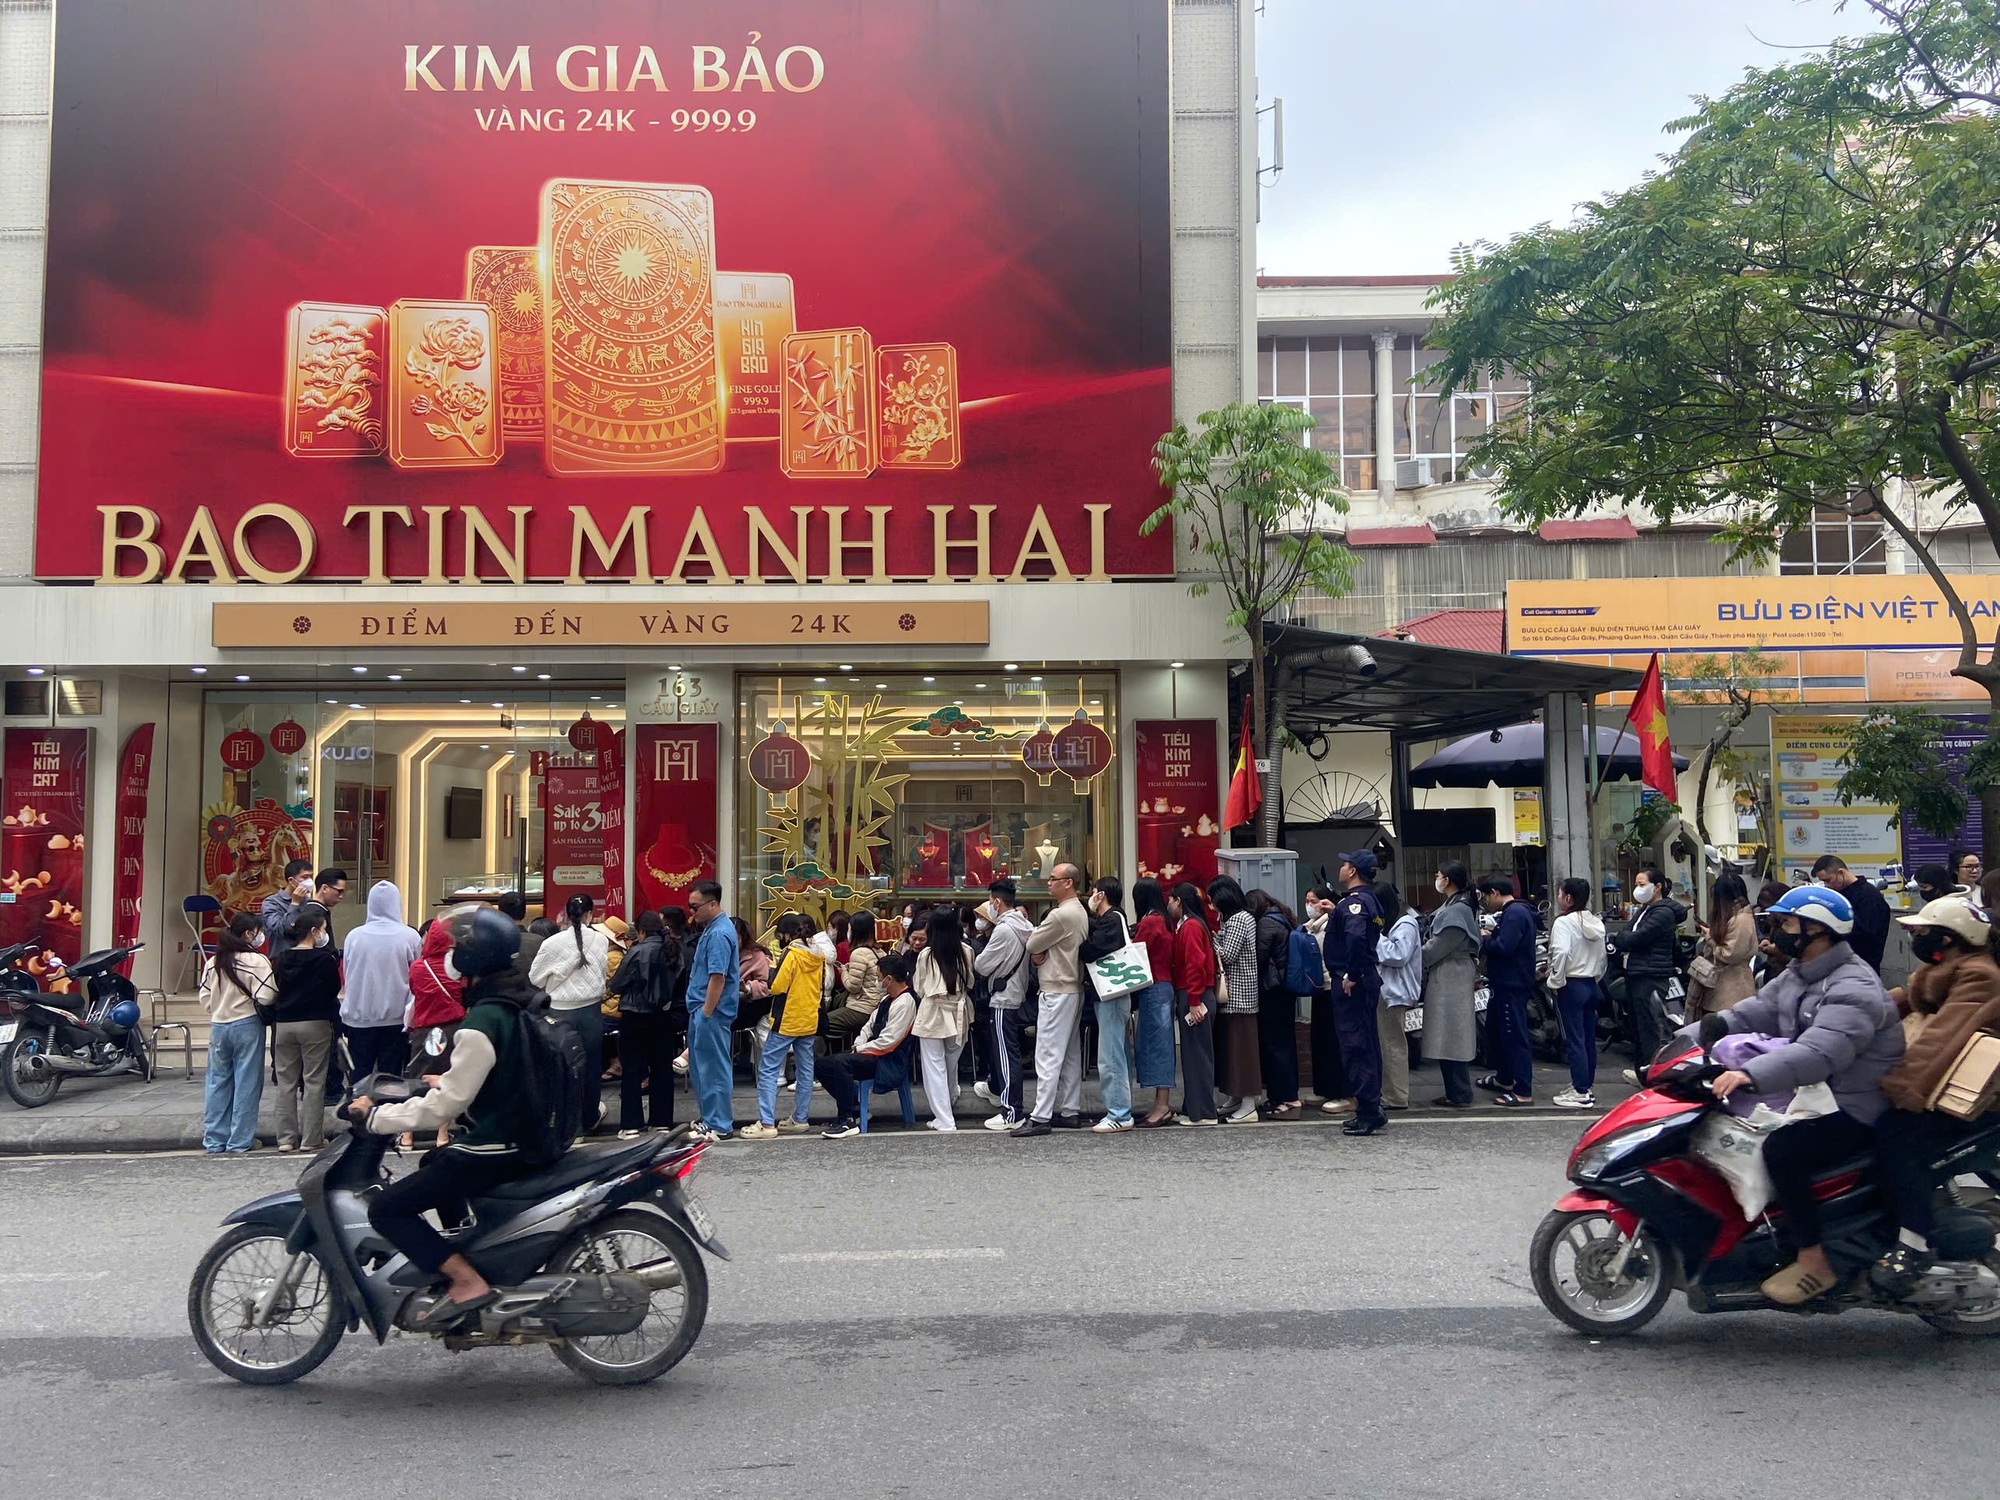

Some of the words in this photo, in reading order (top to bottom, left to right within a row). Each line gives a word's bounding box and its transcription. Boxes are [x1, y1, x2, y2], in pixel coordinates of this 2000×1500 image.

[403, 45, 535, 92] KIM
[556, 45, 671, 92] GIA
[692, 31, 825, 93] BẢO
[474, 104, 566, 132] VÀNG
[577, 108, 636, 132] 24K
[671, 108, 757, 133] 999.9
[729, 385, 752, 393] FINE
[743, 397, 769, 405] 999.9
[96, 503, 318, 585] BAO
[343, 505, 532, 585] TIN
[568, 505, 892, 585] MANH
[927, 504, 1111, 585] HAI
[1718, 598, 1782, 620] BƯU
[1789, 595, 1864, 624] ĐIỆN
[1870, 595, 1939, 623] VIỆT
[361, 609, 448, 636] ĐIỂM
[513, 611, 582, 636] ĐẾN
[640, 611, 730, 634] VÀNG
[791, 614, 851, 633] 24K
[658, 677, 702, 697] 163
[1162, 729, 1190, 746] TIỂU
[1165, 748, 1190, 761] KIM
[33, 757, 60, 770] KIM
[553, 803, 581, 819] Sale
[553, 820, 569, 833] up
[570, 819, 581, 830] to
